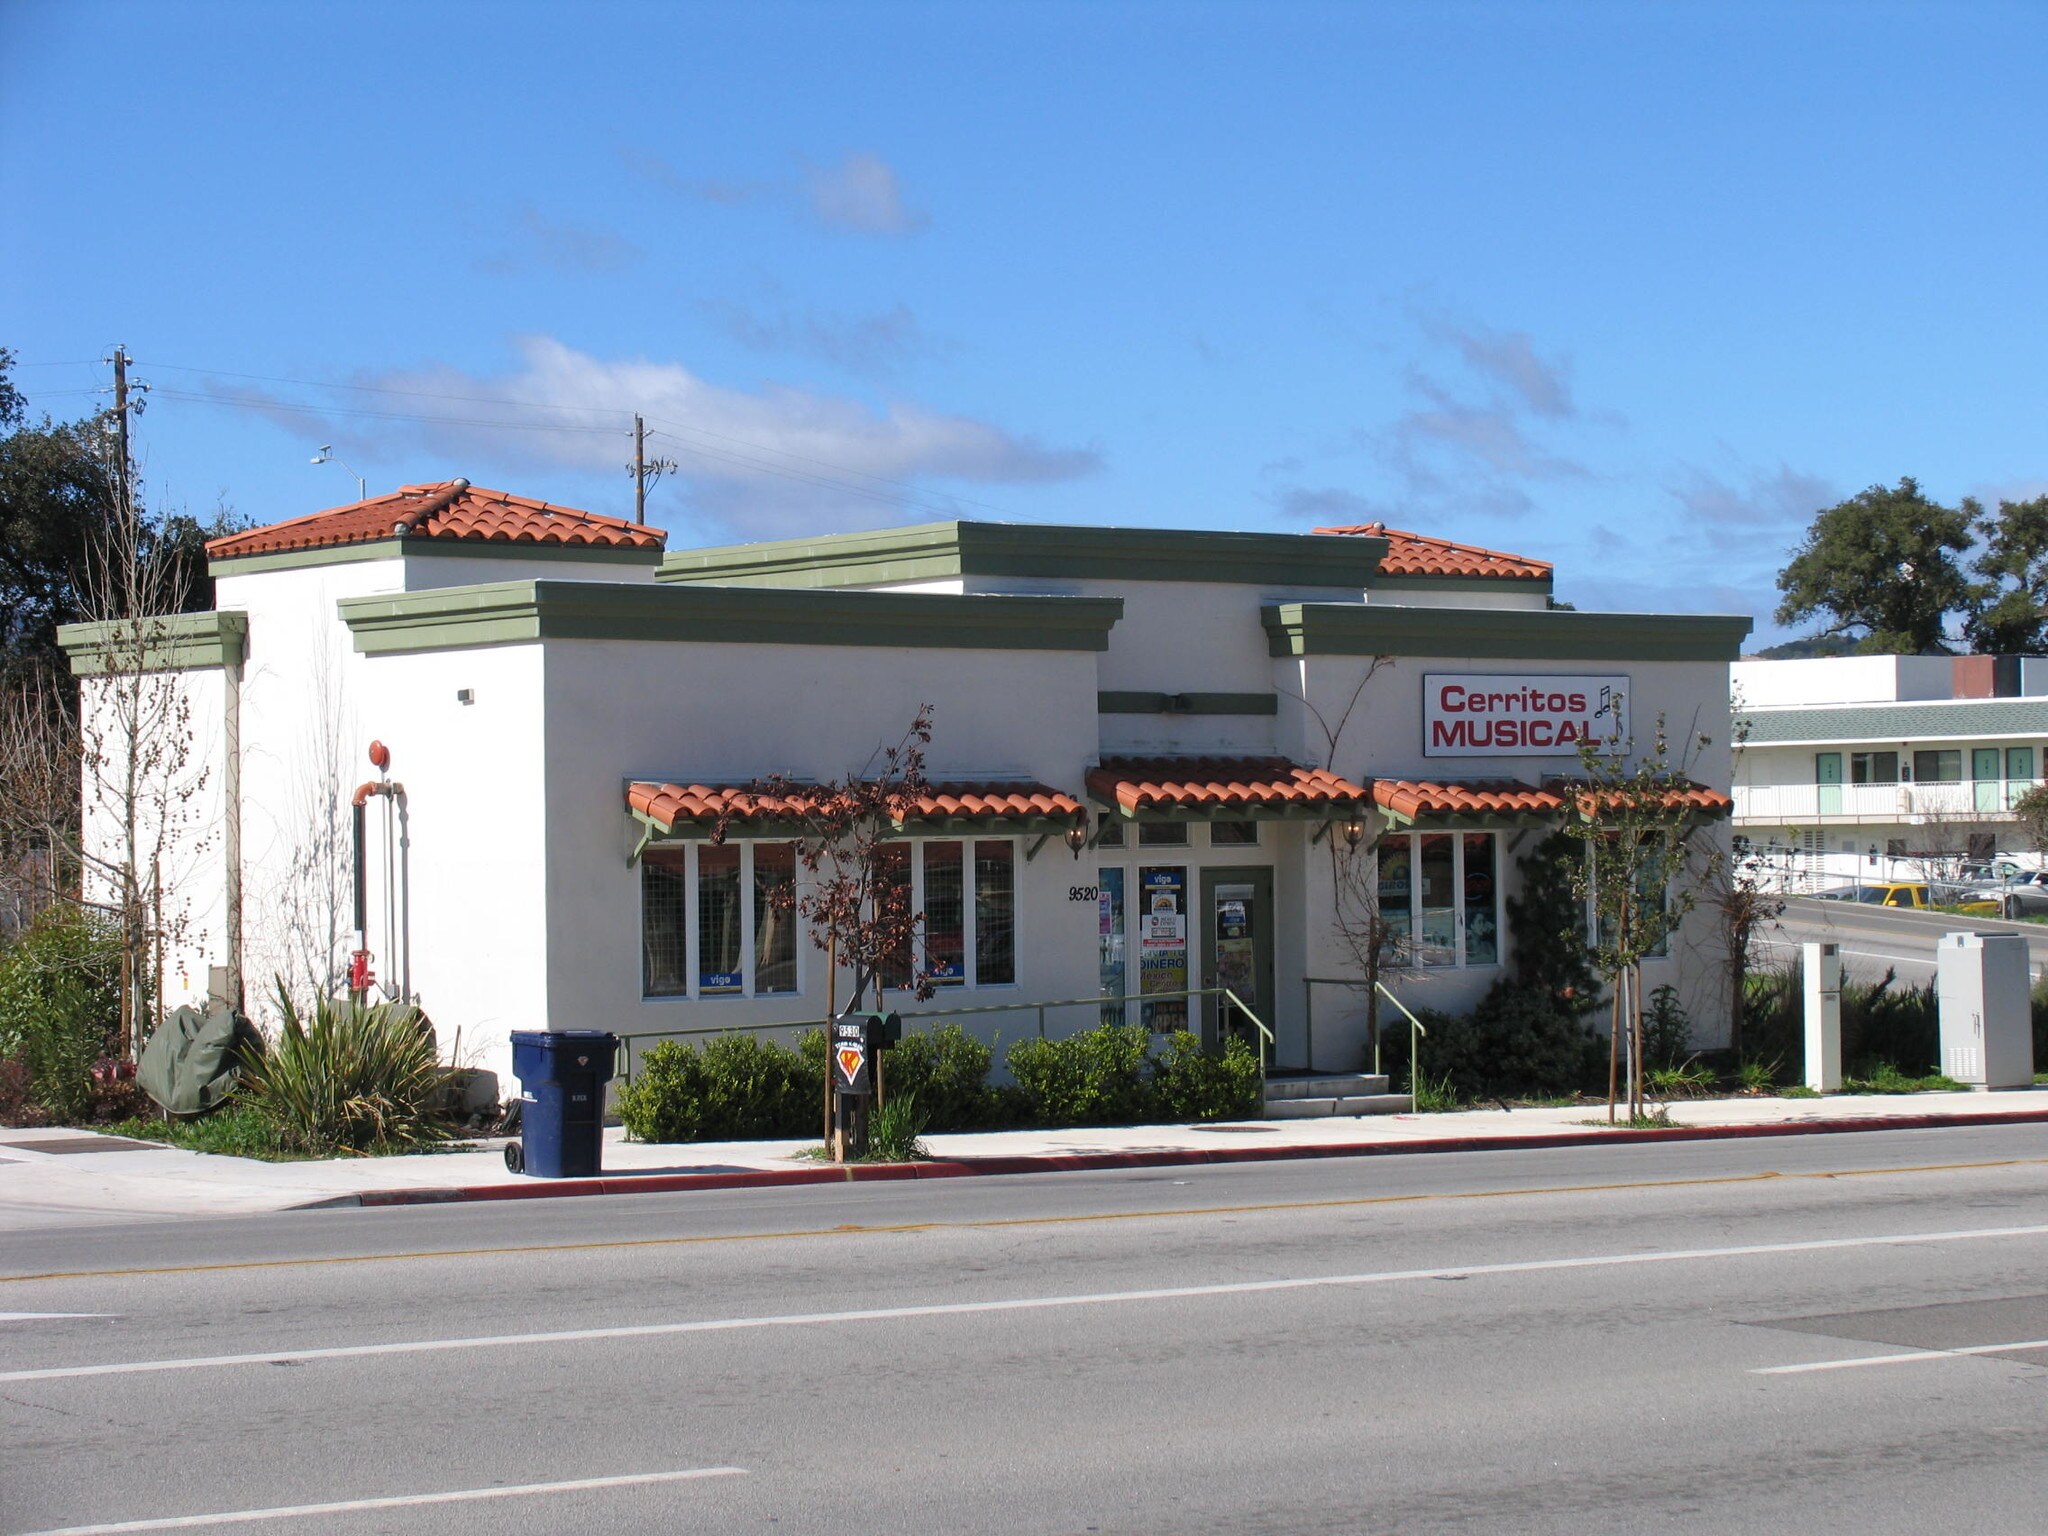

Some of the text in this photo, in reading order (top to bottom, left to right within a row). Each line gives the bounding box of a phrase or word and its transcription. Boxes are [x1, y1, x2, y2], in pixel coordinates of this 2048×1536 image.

[1440, 685, 1587, 713] Cerritos
[1433, 720, 1602, 747] MUSICAL
[1154, 873, 1172, 885] vigo
[1069, 886, 1099, 902] 9520
[1140, 958, 1185, 970] DINERO
[710, 974, 732, 986] vigo
[840, 1026, 860, 1036] 9530
